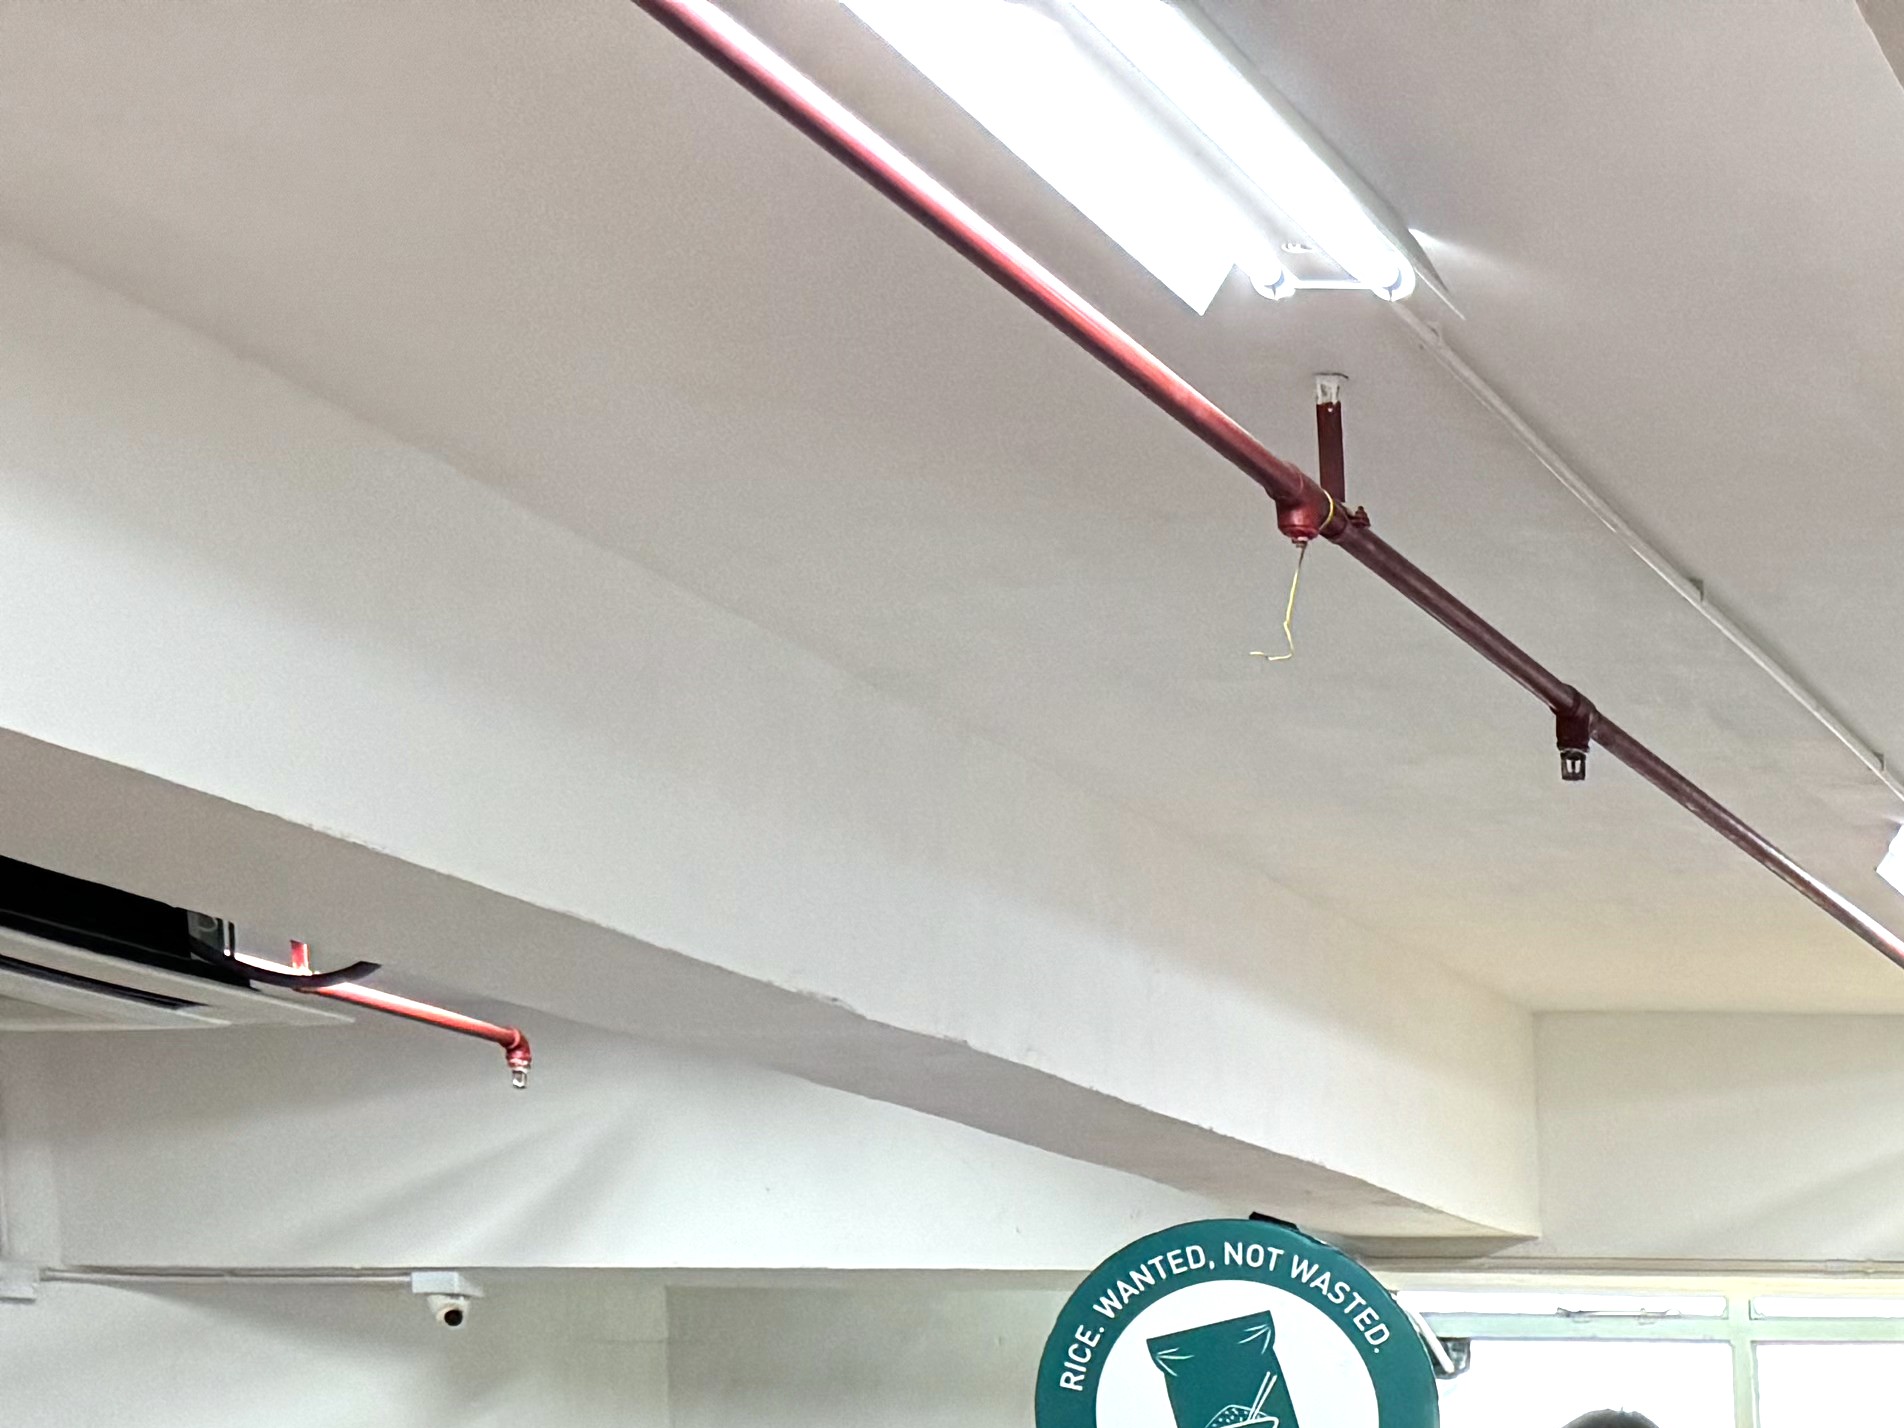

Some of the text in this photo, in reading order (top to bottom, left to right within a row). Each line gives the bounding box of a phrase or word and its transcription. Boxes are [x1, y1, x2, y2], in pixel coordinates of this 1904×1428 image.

[1060, 1242, 1391, 1391] RICE. WANTED, NOT WASTED.
